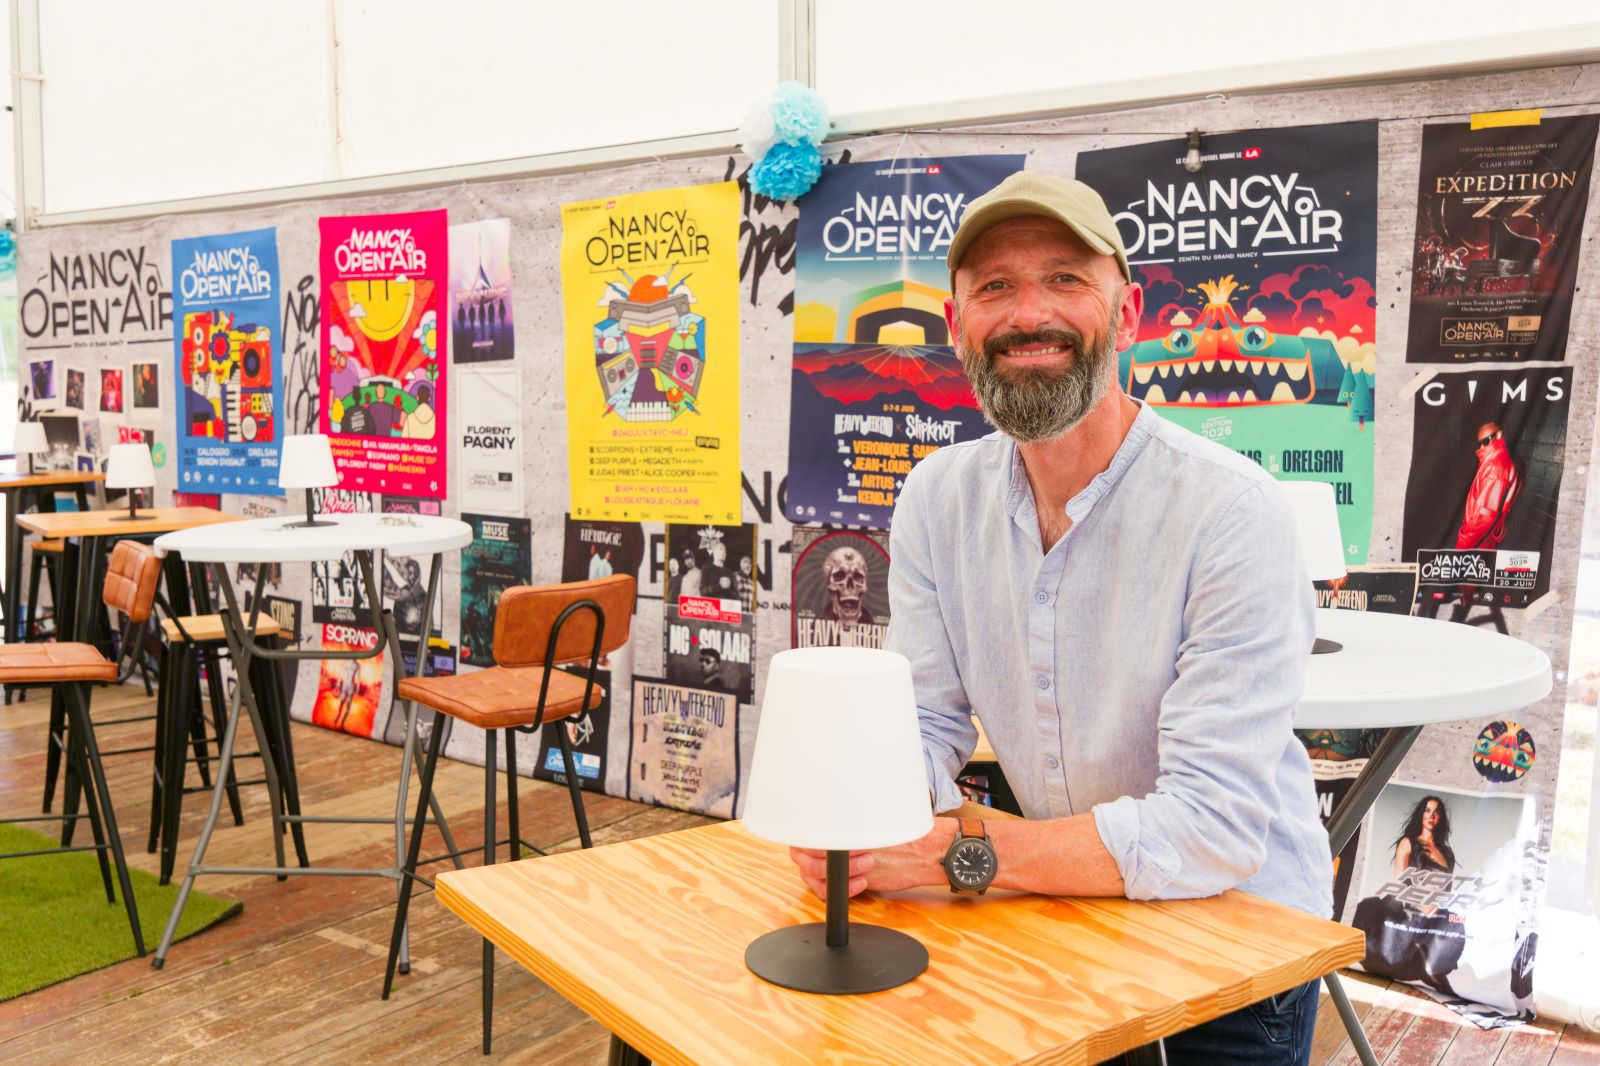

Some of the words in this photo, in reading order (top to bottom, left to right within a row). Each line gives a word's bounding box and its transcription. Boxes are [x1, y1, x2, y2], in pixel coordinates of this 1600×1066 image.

[1245, 149, 1259, 158] LA
[1435, 170, 1577, 194] EXPEDITION
[1147, 171, 1299, 221] NANCY
[855, 190, 965, 227] NANCY
[609, 209, 687, 240] NANCY
[822, 215, 921, 254] OPEN
[1112, 211, 1238, 257] OPEN
[350, 227, 412, 252] NANCY
[586, 236, 658, 266] OPEN
[193, 246, 252, 275] NANCY
[334, 244, 386, 273] OPEN
[1178, 255, 1201, 263] ZENITH
[1213, 252, 1235, 260] GRAND
[1236, 251, 1258, 259] NANCY
[49, 246, 146, 297] NANCY
[180, 270, 232, 299] OPEN
[20, 287, 110, 338] OPEN
[1444, 328, 1481, 341] OPEN
[1457, 321, 1497, 332] NANCY
[463, 435, 516, 449] PAGNY
[467, 425, 512, 435] FLORENT
[596, 446, 635, 454] SCORPIONS
[639, 446, 673, 454] EXTREME
[643, 457, 682, 465] MEGADETH
[852, 439, 910, 459] VERONIQUE
[1282, 449, 1344, 473] ORELSAN
[643, 469, 663, 477] ALICE
[665, 469, 696, 477] COOPER
[852, 456, 913, 474] JEAN-LOUIS
[861, 473, 895, 490] ARTUS
[857, 489, 894, 507] KENDJI
[482, 524, 509, 538] MUSE
[1421, 562, 1460, 579] OPEN
[1433, 553, 1481, 567] NANCY
[326, 624, 379, 649] SOPRANO
[669, 624, 690, 656] MC
[699, 627, 750, 664] SOLAAR
[797, 618, 840, 649] HEAVY
[643, 685, 678, 716] HEAVY
[1397, 866, 1498, 892] KATY
[1373, 881, 1505, 911] PERRY
